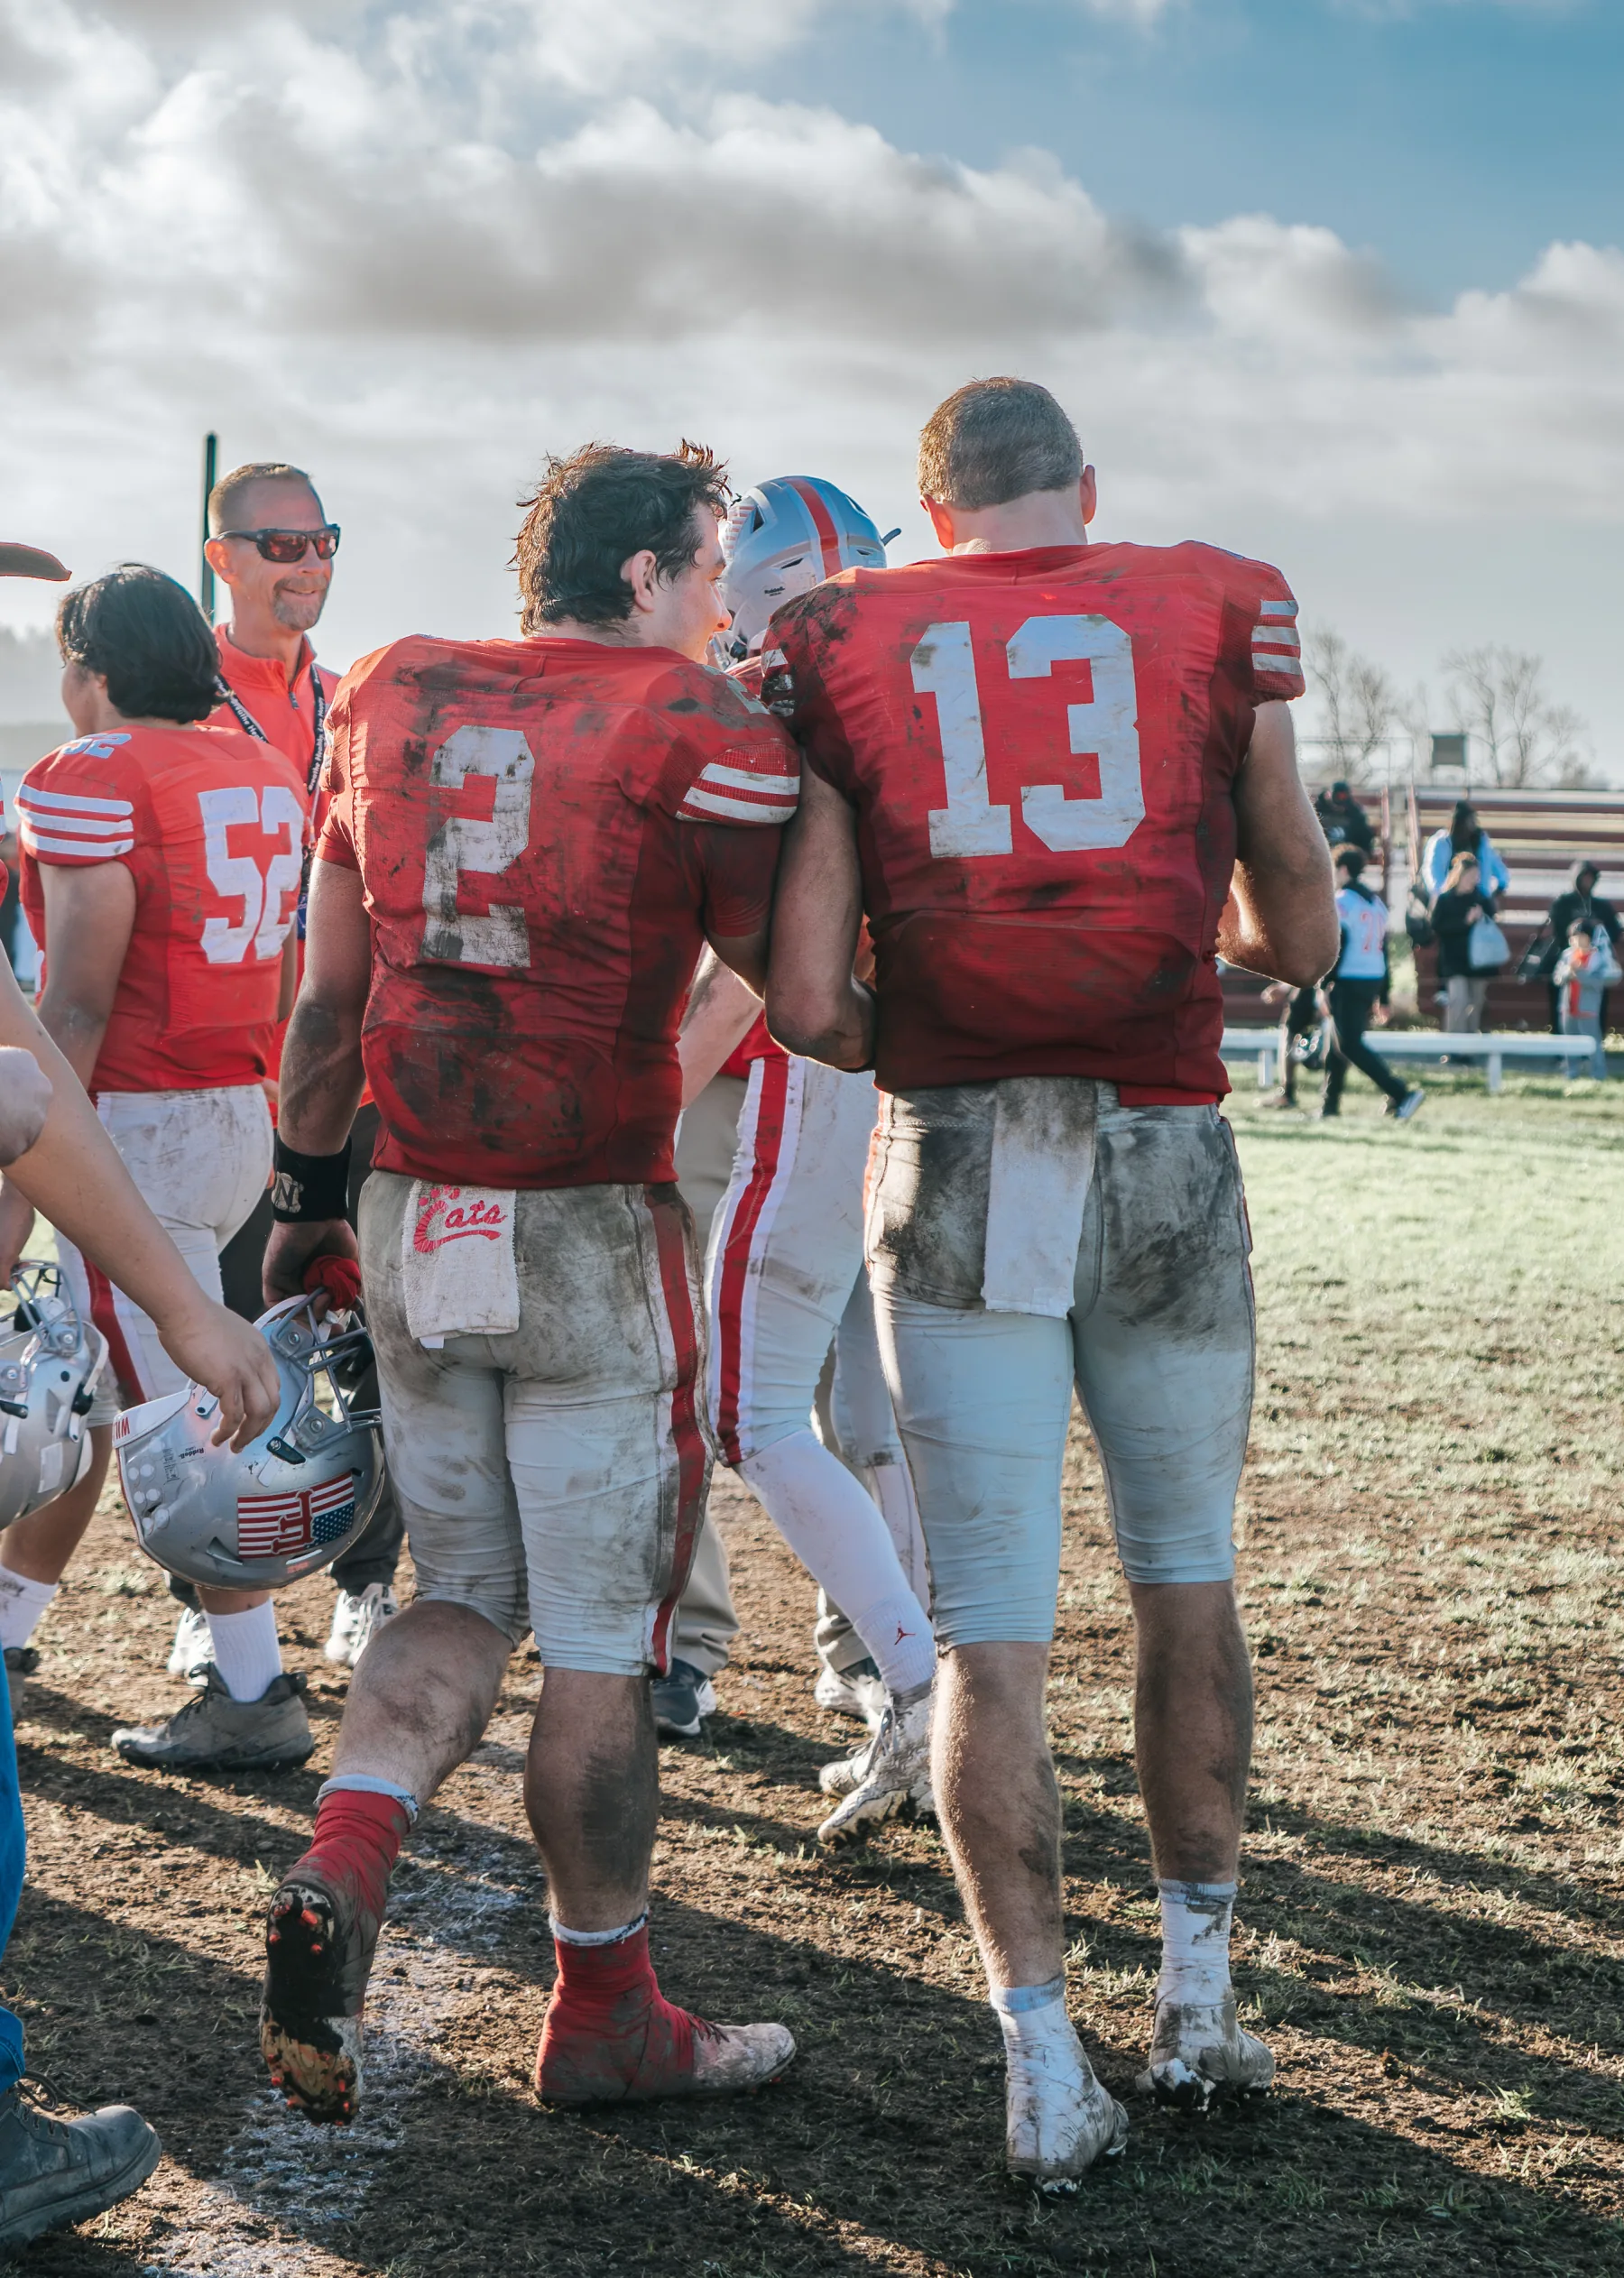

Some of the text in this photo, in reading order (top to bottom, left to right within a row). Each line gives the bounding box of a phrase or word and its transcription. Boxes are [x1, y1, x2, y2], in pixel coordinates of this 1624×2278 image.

[909, 613, 1146, 858] 13
[198, 786, 304, 964] 52
[420, 724, 535, 967] 2
[413, 1200, 508, 1253] Cats
